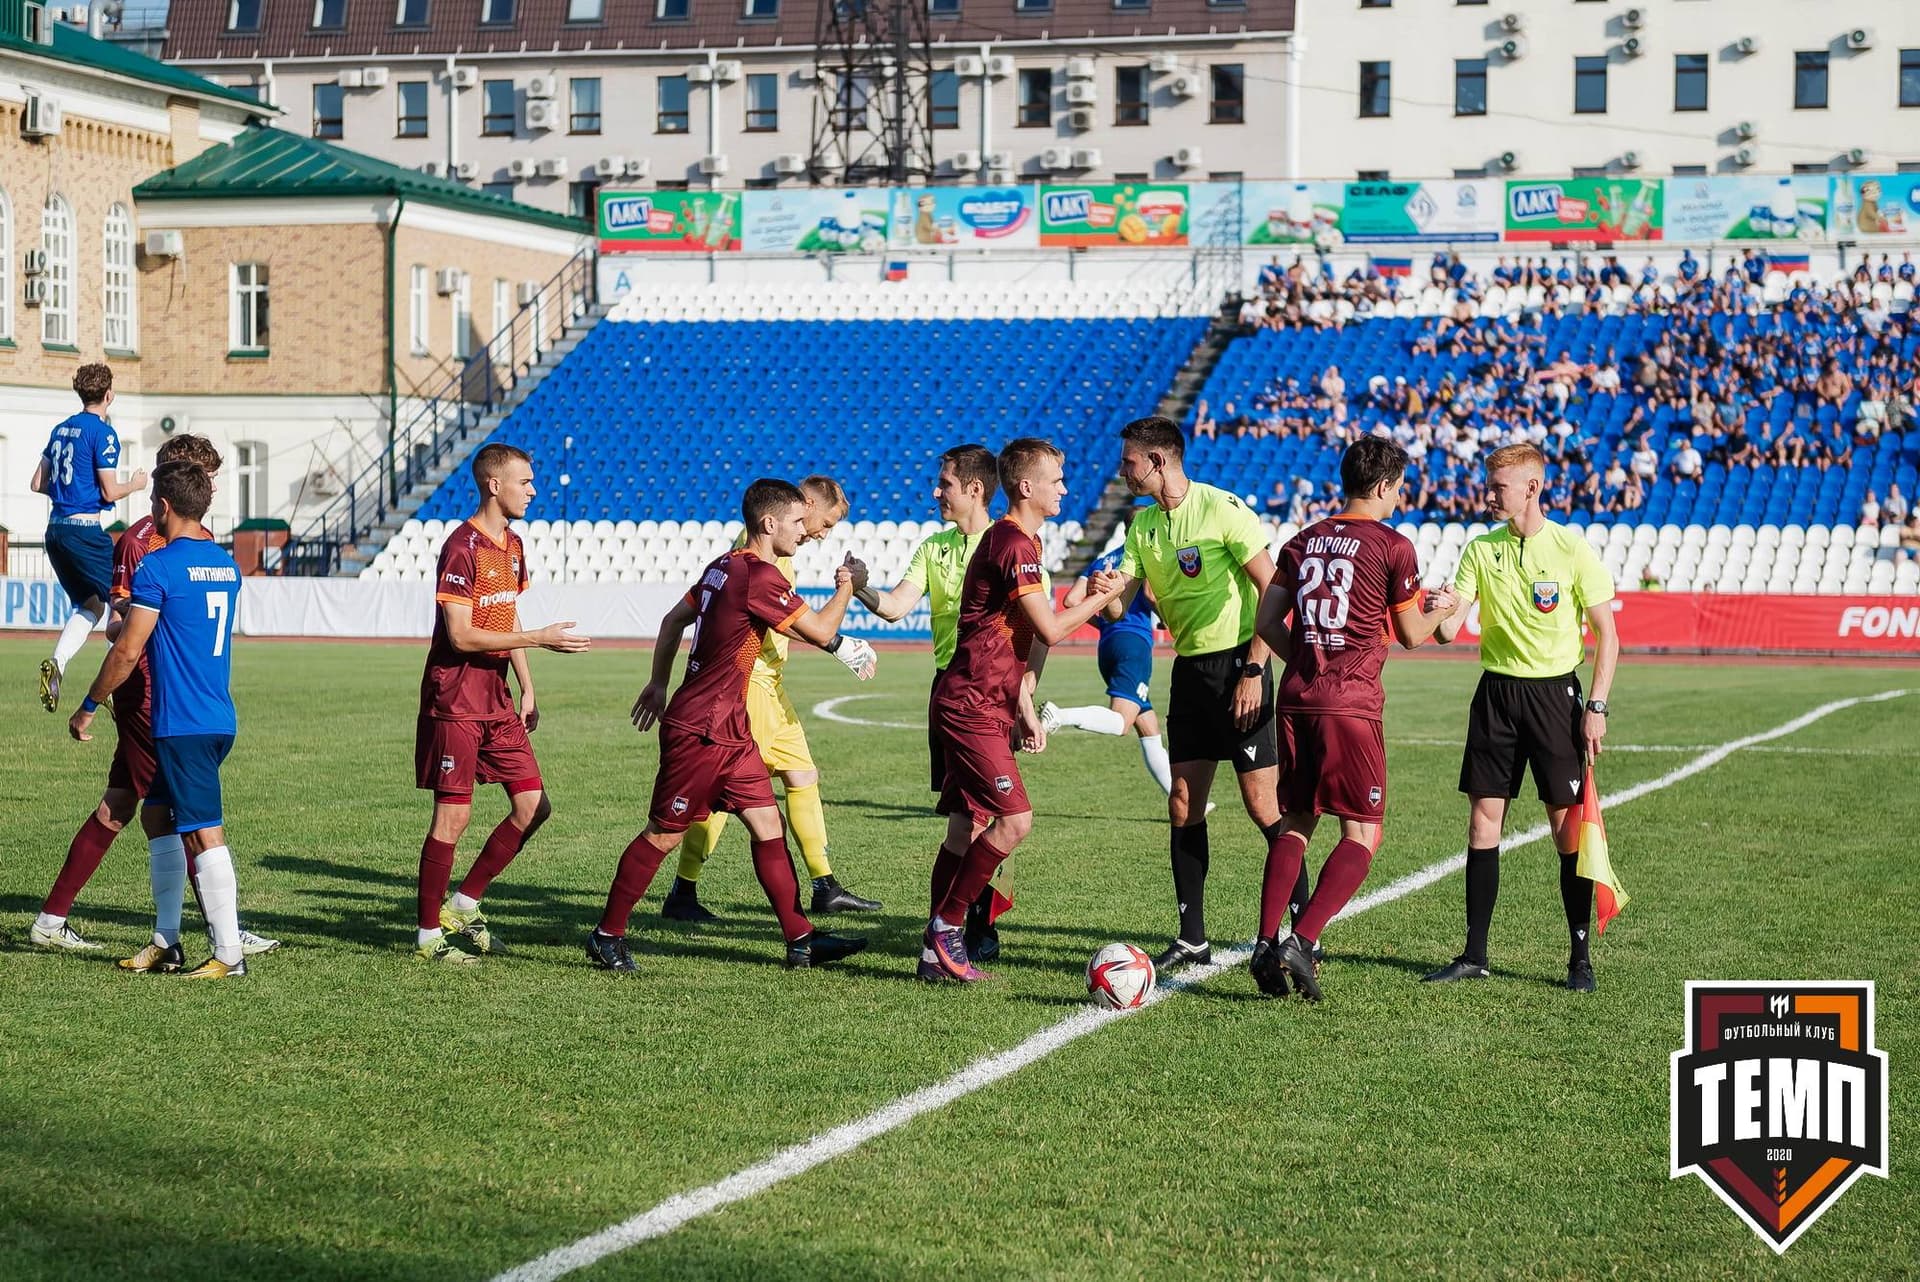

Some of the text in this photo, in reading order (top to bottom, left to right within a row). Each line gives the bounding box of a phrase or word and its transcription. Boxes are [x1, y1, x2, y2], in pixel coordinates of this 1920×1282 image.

[51, 440, 75, 486] 33
[1306, 535, 1361, 558] ВОРОНА
[446, 573, 466, 586] ПСБ
[1296, 557, 1355, 629] 23
[205, 591, 229, 657] 7
[1838, 606, 1920, 638] FON
